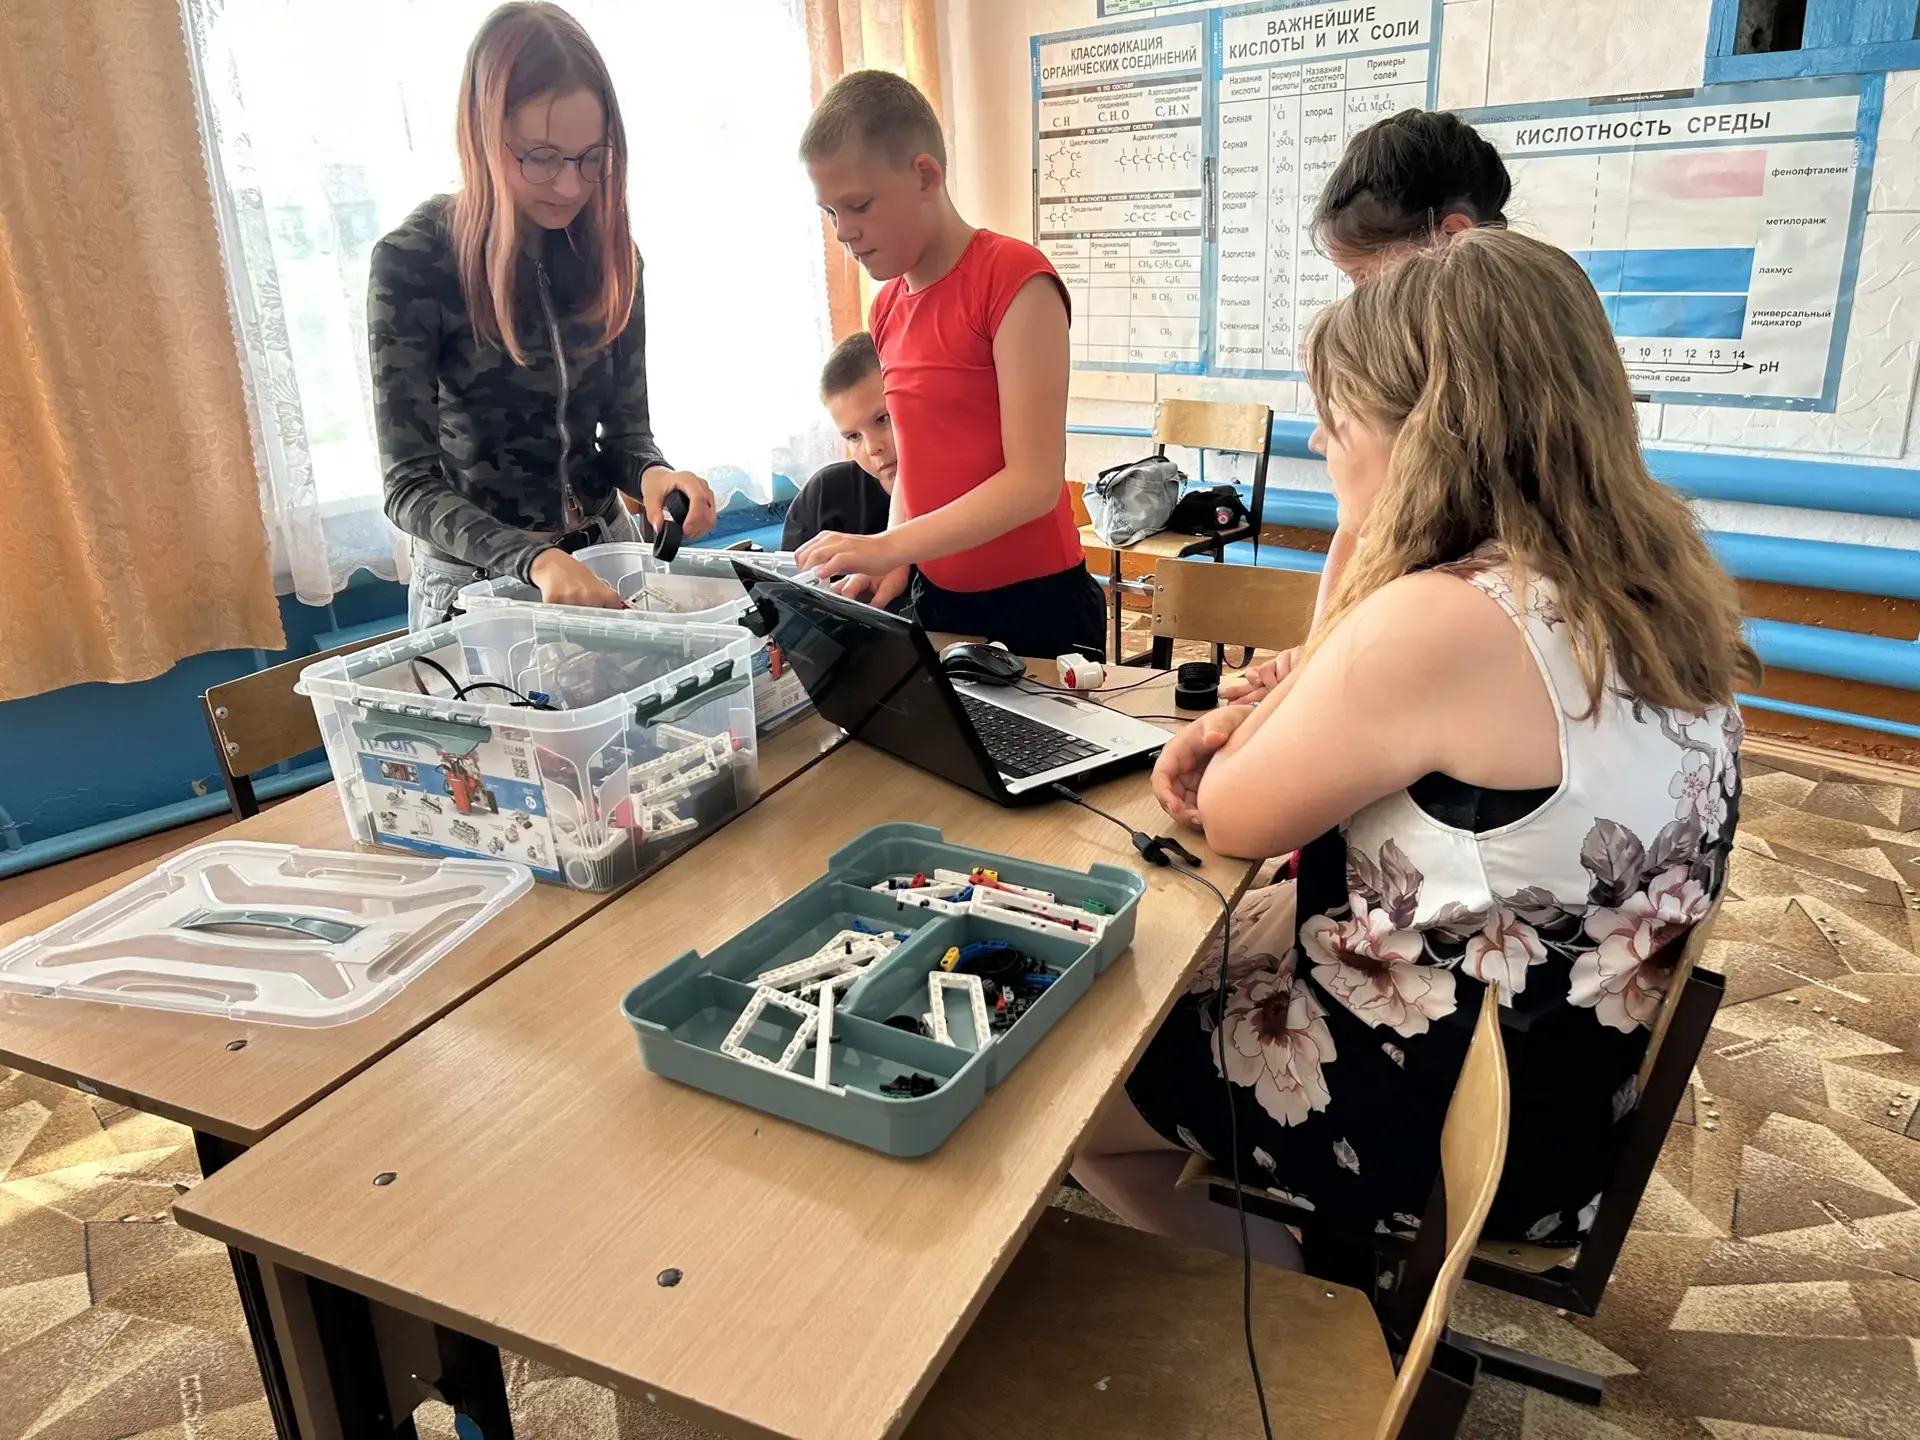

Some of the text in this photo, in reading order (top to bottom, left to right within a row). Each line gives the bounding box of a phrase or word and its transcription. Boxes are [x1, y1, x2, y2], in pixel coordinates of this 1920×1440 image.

[1268, 6, 1376, 35] ВАЖНЕЙШИЕ
[1229, 36, 1305, 59] КИСЛОТЫ
[1316, 33, 1326, 48] И
[1338, 28, 1359, 45] ИХ
[1371, 20, 1419, 40] СОЛИ
[1071, 36, 1163, 60] КЛАССИФИКАЦИЯ
[1043, 58, 1119, 80] ОРГАНИЧЕСКИХ
[1122, 46, 1197, 70] СОЕДИНЕНИЙ
[1367, 57, 1405, 70] Примеры
[1271, 70, 1300, 80] Формула
[1306, 66, 1341, 76] Название
[1373, 71, 1397, 80] солей
[1229, 75, 1262, 84] Название
[1303, 74, 1344, 84] кислотного
[1148, 86, 1197, 96] Азотсодержащие
[1231, 86, 1260, 96] кислоты
[1272, 83, 1299, 91] кислоты
[1309, 82, 1337, 91] остатка
[1083, 91, 1143, 103] Кислородсодержащие
[1305, 108, 1333, 117] хлорид
[1223, 114, 1252, 124] Соляная
[1516, 112, 1771, 145] КИСЛОТНОСТЬ СРЕДЫ
[1133, 132, 1177, 141] Ациклические
[1304, 134, 1336, 145] сульфат
[1223, 140, 1247, 150] Серная
[1222, 165, 1258, 175] Сернистая
[1772, 166, 1848, 177] фенолфталеин
[1222, 190, 1258, 199] Сероводо-
[1222, 202, 1246, 210] родная
[1766, 217, 1826, 227] метилоранж
[1222, 226, 1249, 234] Азотная
[1222, 250, 1255, 258] Азотистая
[1759, 266, 1793, 275] лакмус
[1221, 274, 1259, 283] Фосфорная
[1300, 274, 1328, 284] фосфат
[1220, 298, 1250, 307] Угольная
[1300, 298, 1331, 307] карбонат
[1752, 309, 1831, 319] универсальный
[1220, 322, 1259, 331] Кремниевая
[1751, 319, 1802, 327] индикатор
[1220, 345, 1262, 354] Марганцовая
[1640, 348, 1651, 357] 10
[1662, 348, 1672, 357] 11
[1685, 349, 1697, 358] 12
[1708, 350, 1720, 359] 13
[1732, 350, 1745, 360] 14
[1759, 361, 1779, 374] pH
